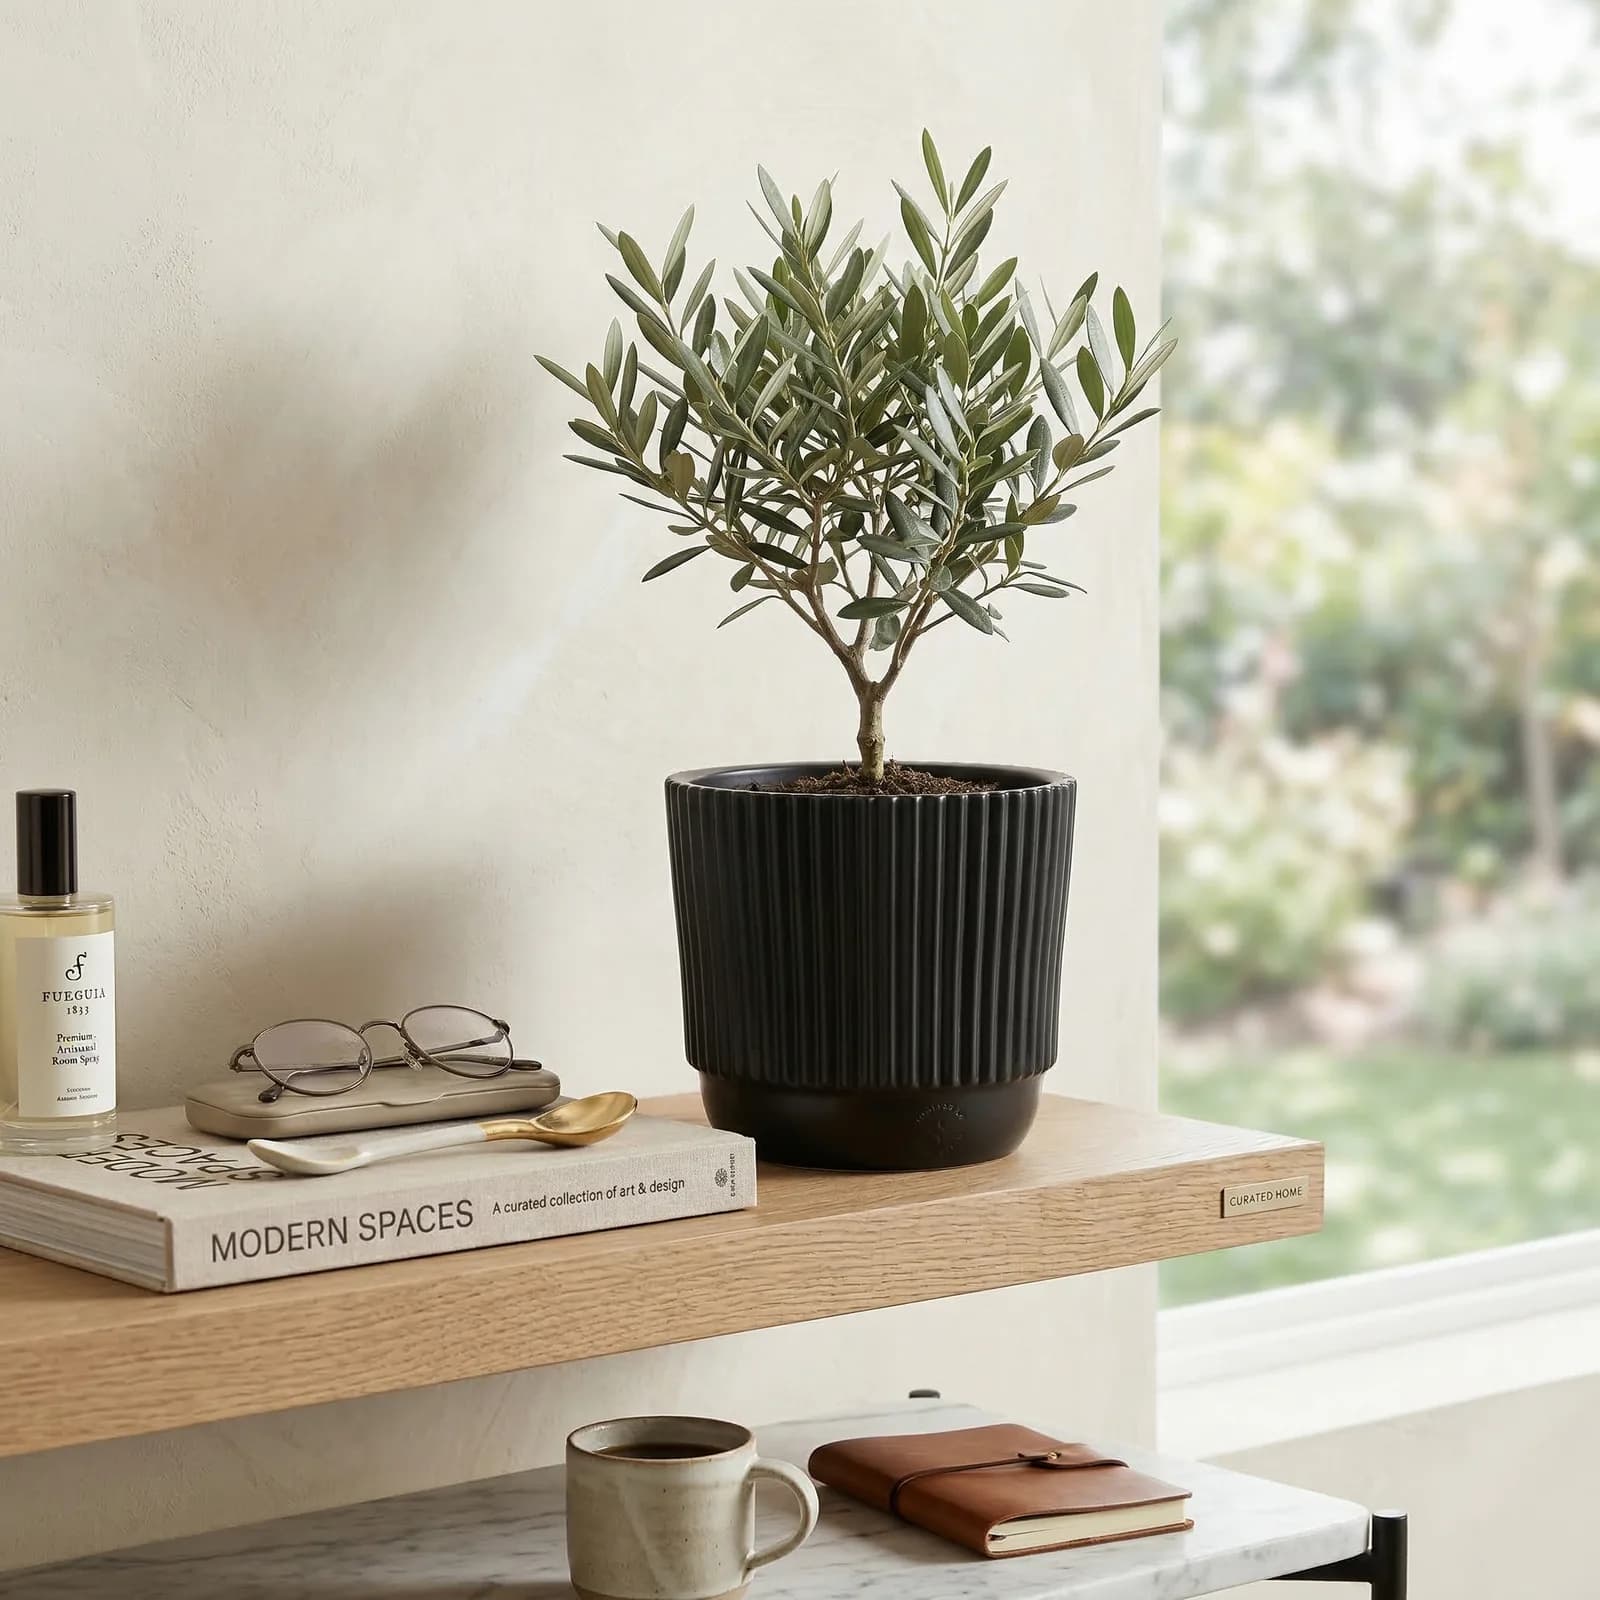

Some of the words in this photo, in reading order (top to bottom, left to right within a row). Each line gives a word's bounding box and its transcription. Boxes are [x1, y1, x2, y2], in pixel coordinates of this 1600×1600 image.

[42, 988, 106, 1003] FUEGUIA
[66, 1006, 90, 1016] 1833
[52, 1056, 78, 1065] Room
[492, 1202, 502, 1215] A
[504, 1194, 546, 1213] curated
[549, 1189, 603, 1207] collection
[606, 1185, 618, 1199] of
[620, 1183, 635, 1197] art
[638, 1182, 647, 1194] &
[650, 1177, 685, 1195] design
[1229, 1191, 1273, 1207] CURATED
[1275, 1186, 1303, 1199] HOME
[211, 1216, 348, 1263] MODERN
[358, 1199, 474, 1241] SPACES
